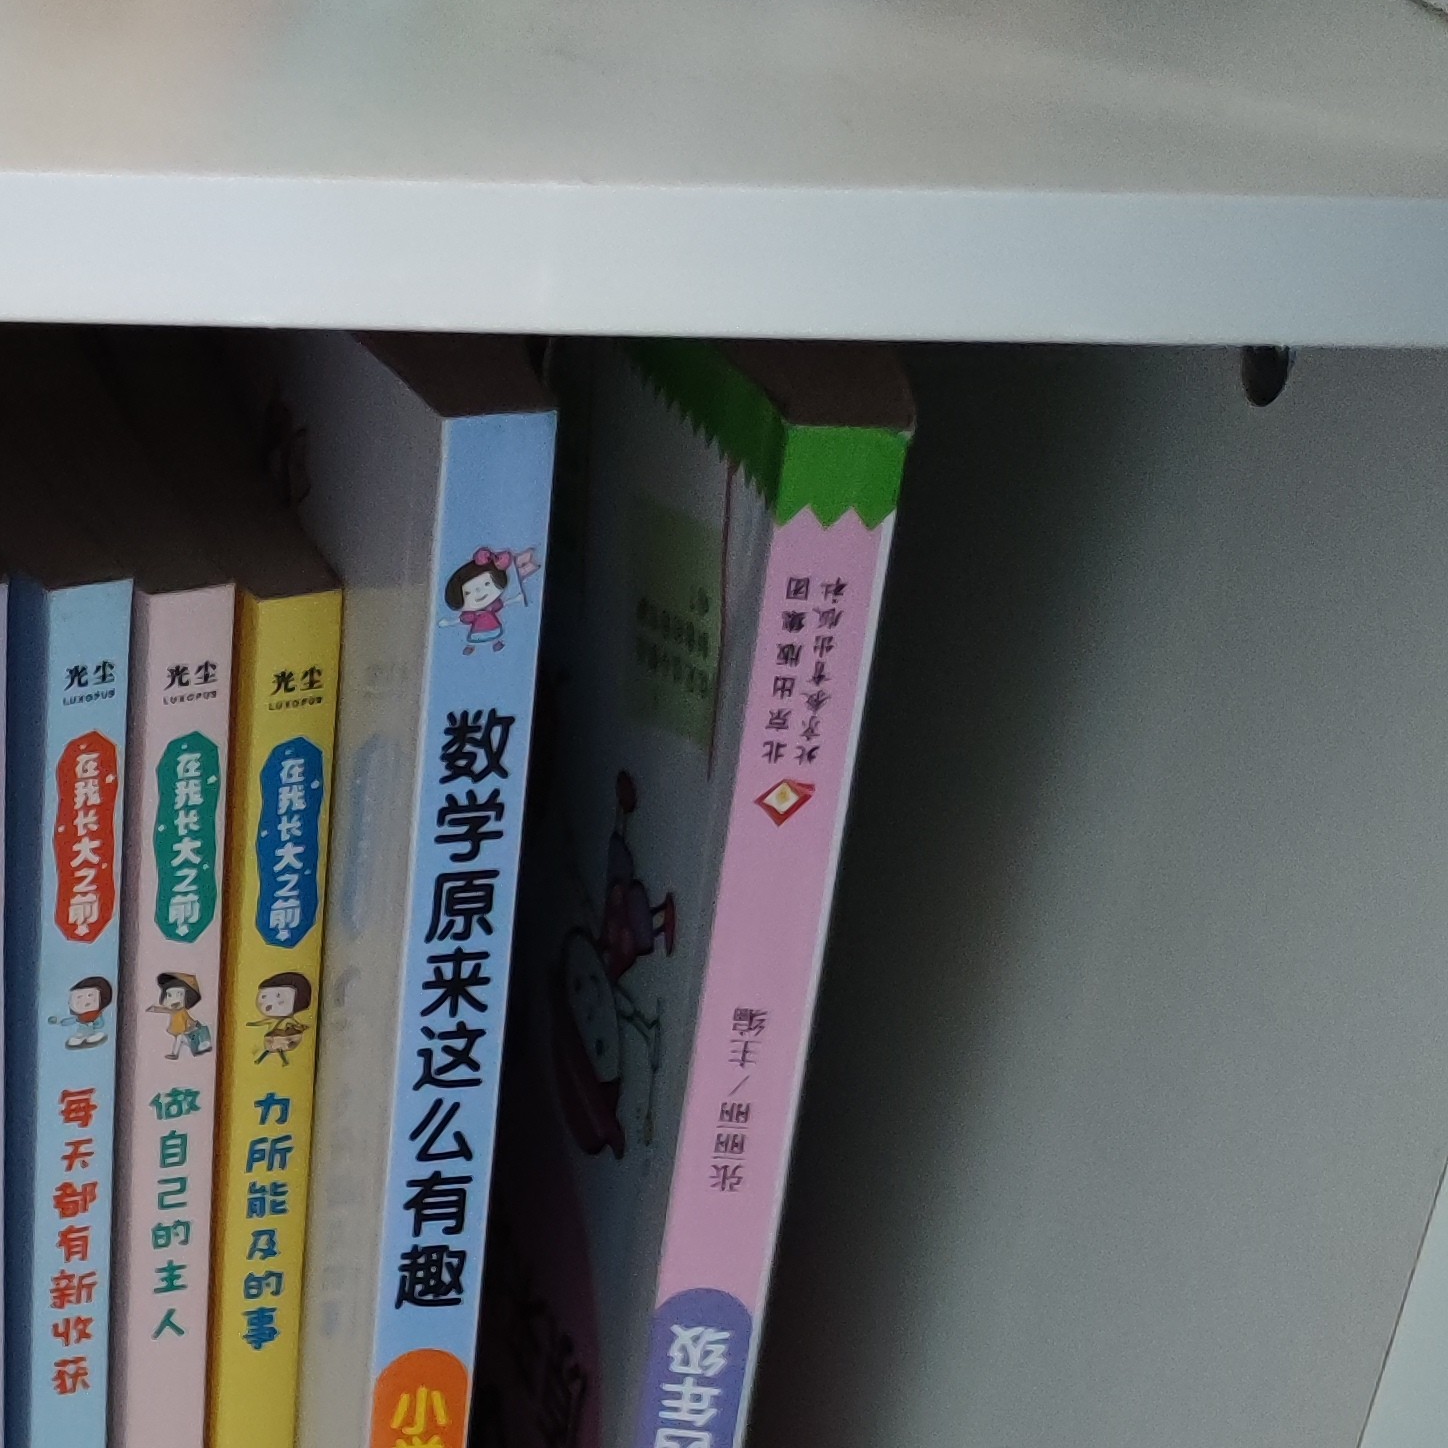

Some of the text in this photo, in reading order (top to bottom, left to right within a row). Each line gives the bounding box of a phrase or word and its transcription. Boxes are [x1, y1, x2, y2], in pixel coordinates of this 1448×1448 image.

[64, 659, 117, 690] 光尘
[166, 659, 219, 690] 光尘
[270, 663, 325, 695] 光尘
[68, 753, 102, 924] 在我长大之前
[171, 752, 205, 924] 在我长大之前
[270, 757, 308, 929] 在我长大之前
[394, 707, 516, 1311] 数学原来这么有趣
[48, 1086, 100, 1399] 每天都有新收获
[149, 1088, 203, 1342] 做自己的主人
[243, 1090, 295, 1352] 力所能及的事
